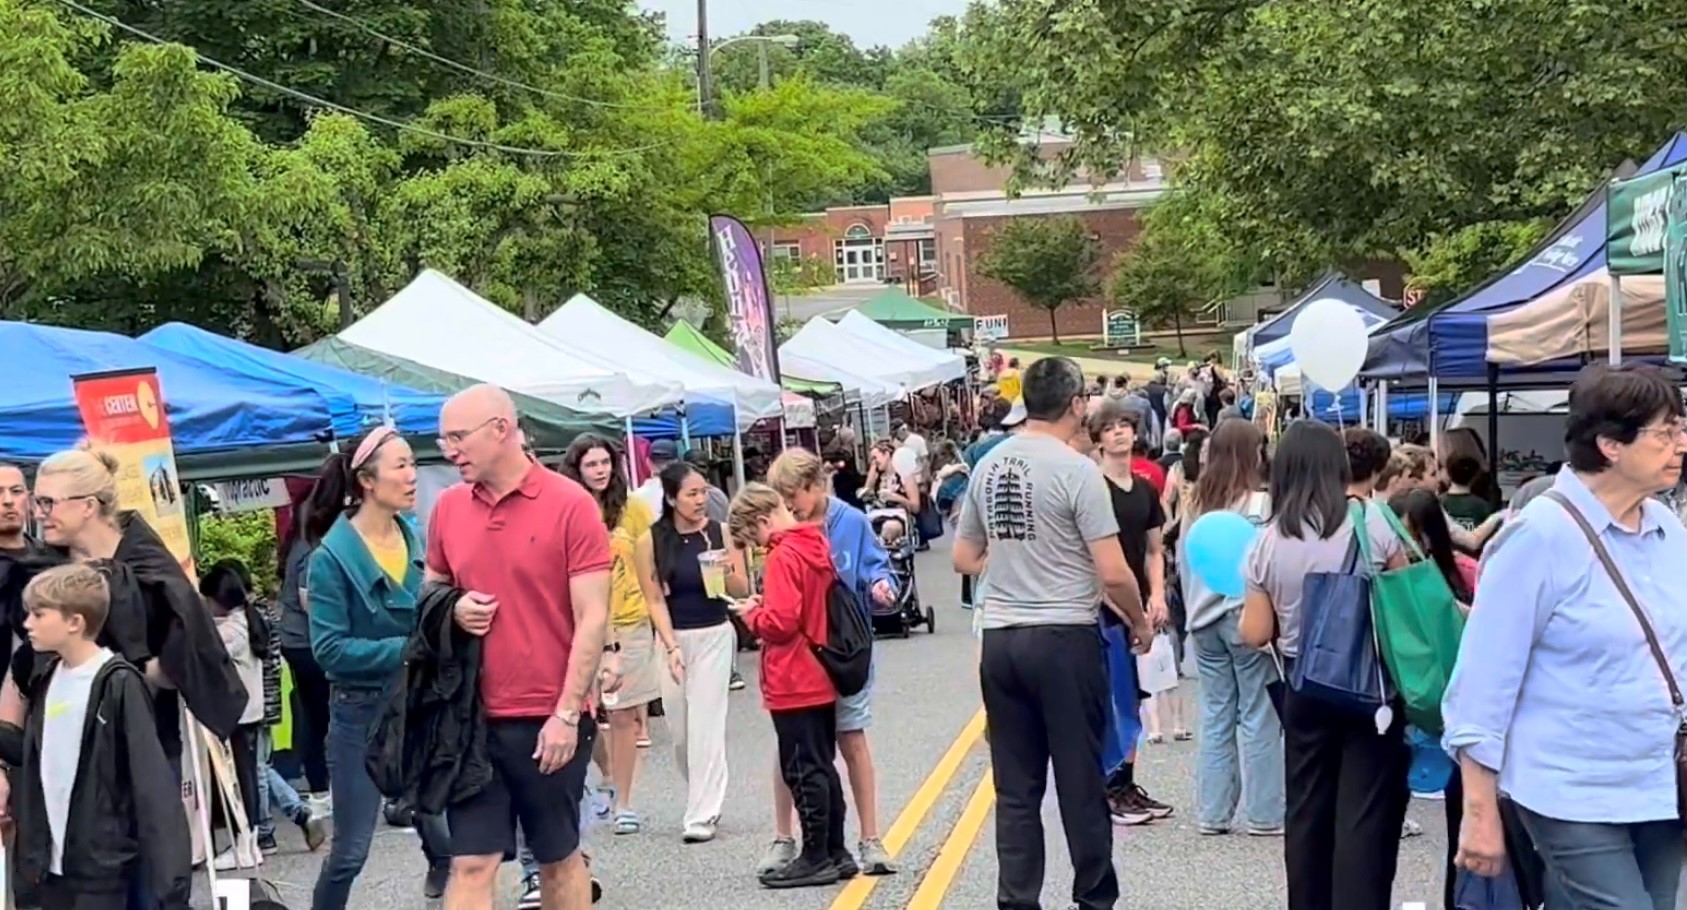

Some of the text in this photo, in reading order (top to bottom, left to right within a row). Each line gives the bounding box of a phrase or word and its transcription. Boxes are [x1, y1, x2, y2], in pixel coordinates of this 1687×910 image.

[985, 456, 1037, 541] PATAGONIA TRAIL RUNNING
